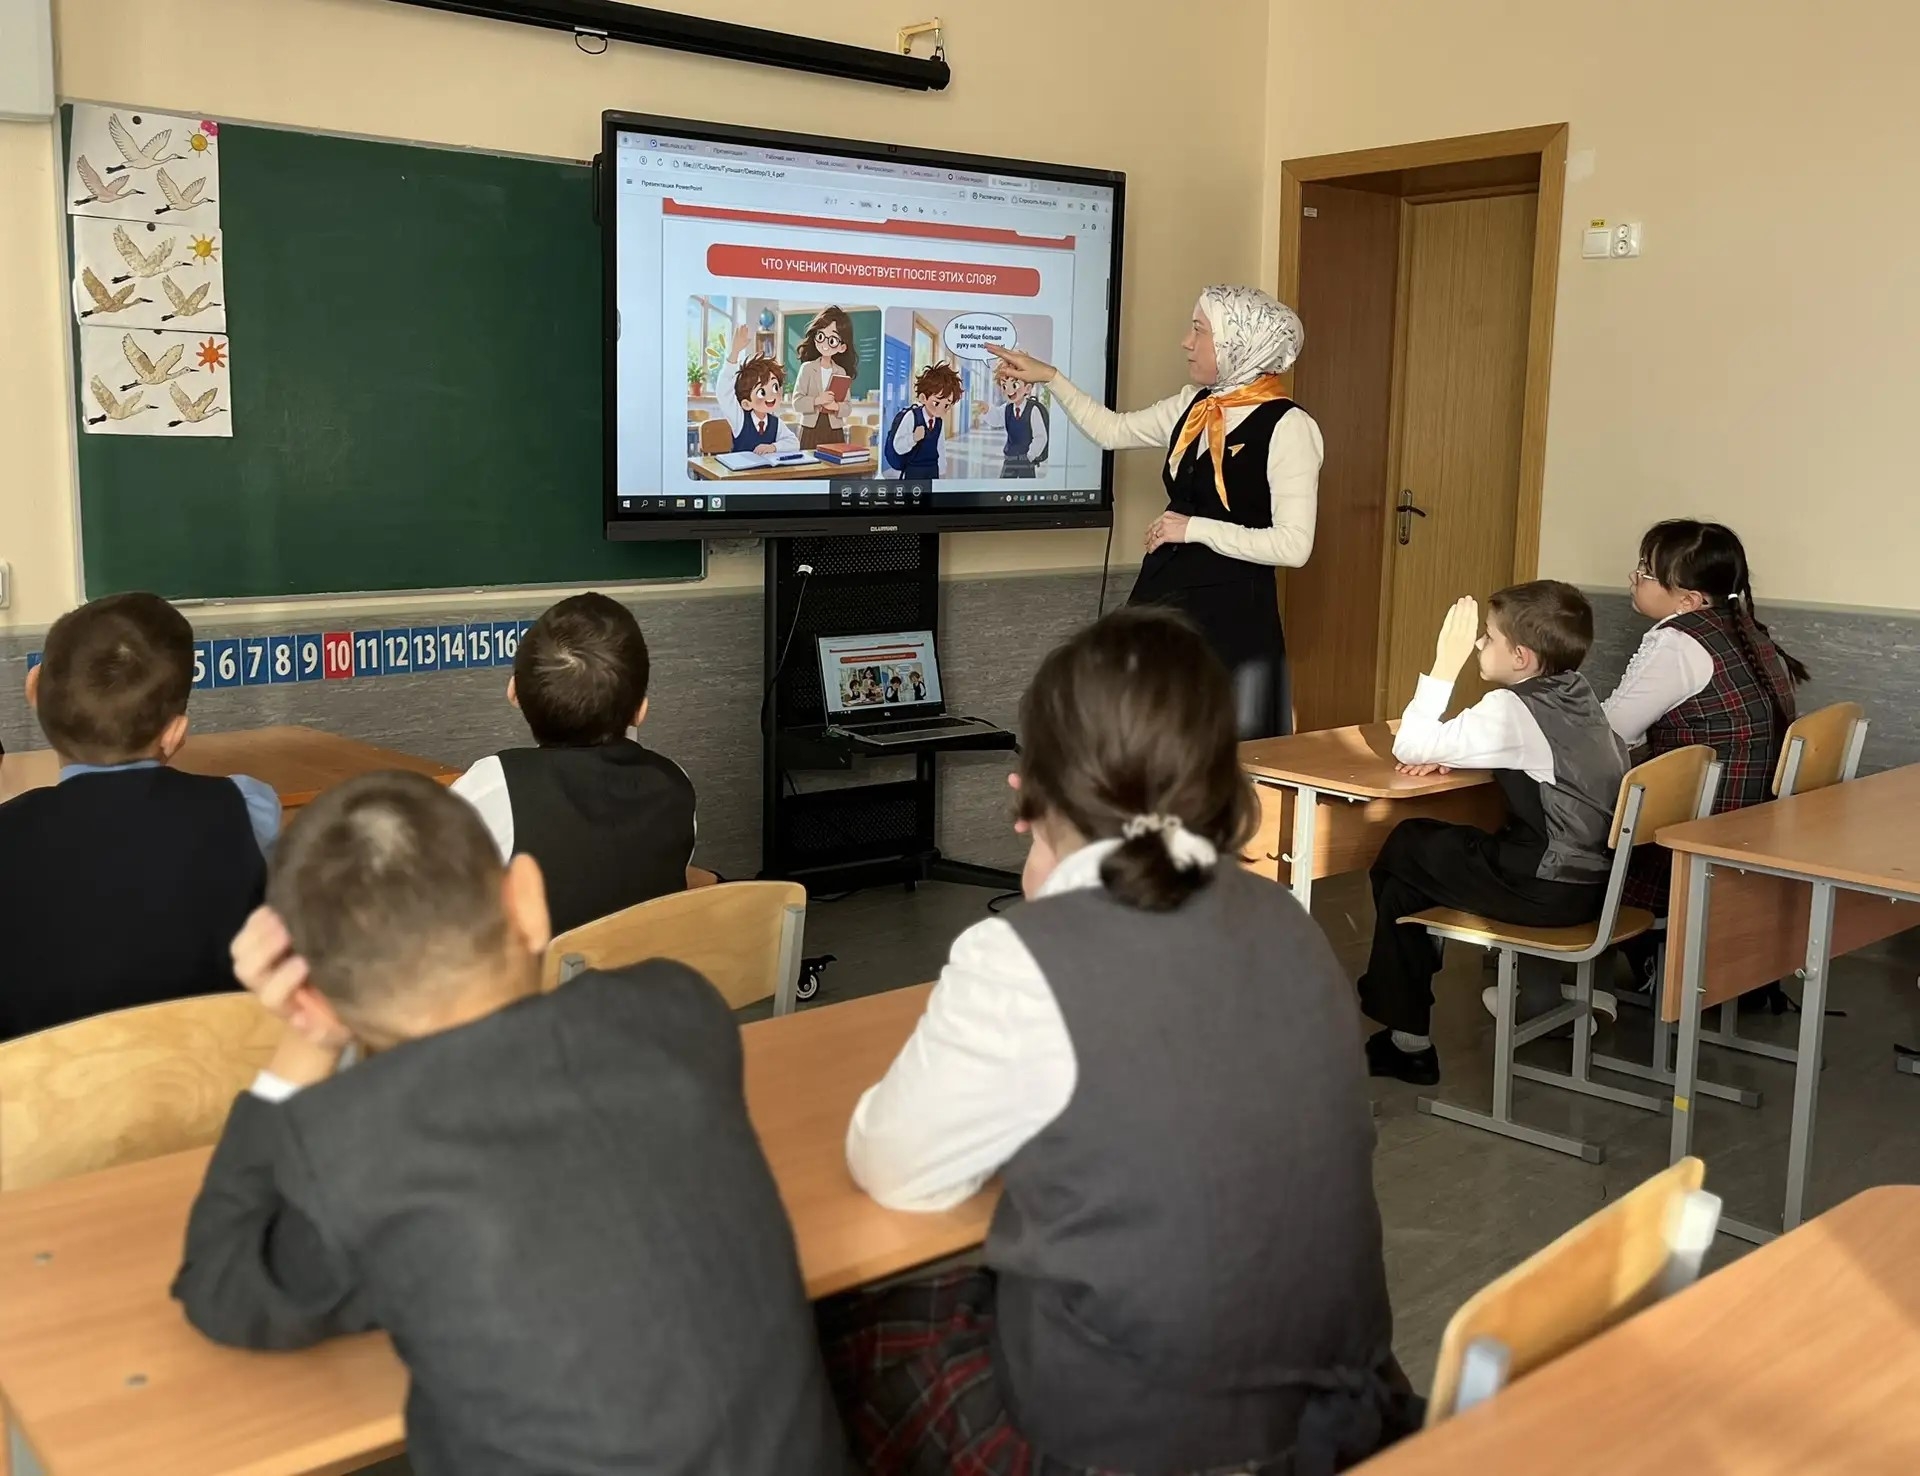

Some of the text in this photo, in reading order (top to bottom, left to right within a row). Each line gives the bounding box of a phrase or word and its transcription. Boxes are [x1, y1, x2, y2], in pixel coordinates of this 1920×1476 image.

[675, 183, 703, 191] PowerPoint
[761, 257, 997, 286] ЧТО УЧЕНИК ПОЧУВСТВУЕТ ПОСЛЕ ЭТИХ СЛОВ?
[975, 324, 992, 332] твоём
[960, 333, 1002, 341] вообще больше
[956, 342, 969, 350] руку
[193, 628, 517, 682] 5 6 7 8 9 10 11 12 13 14 15 16
